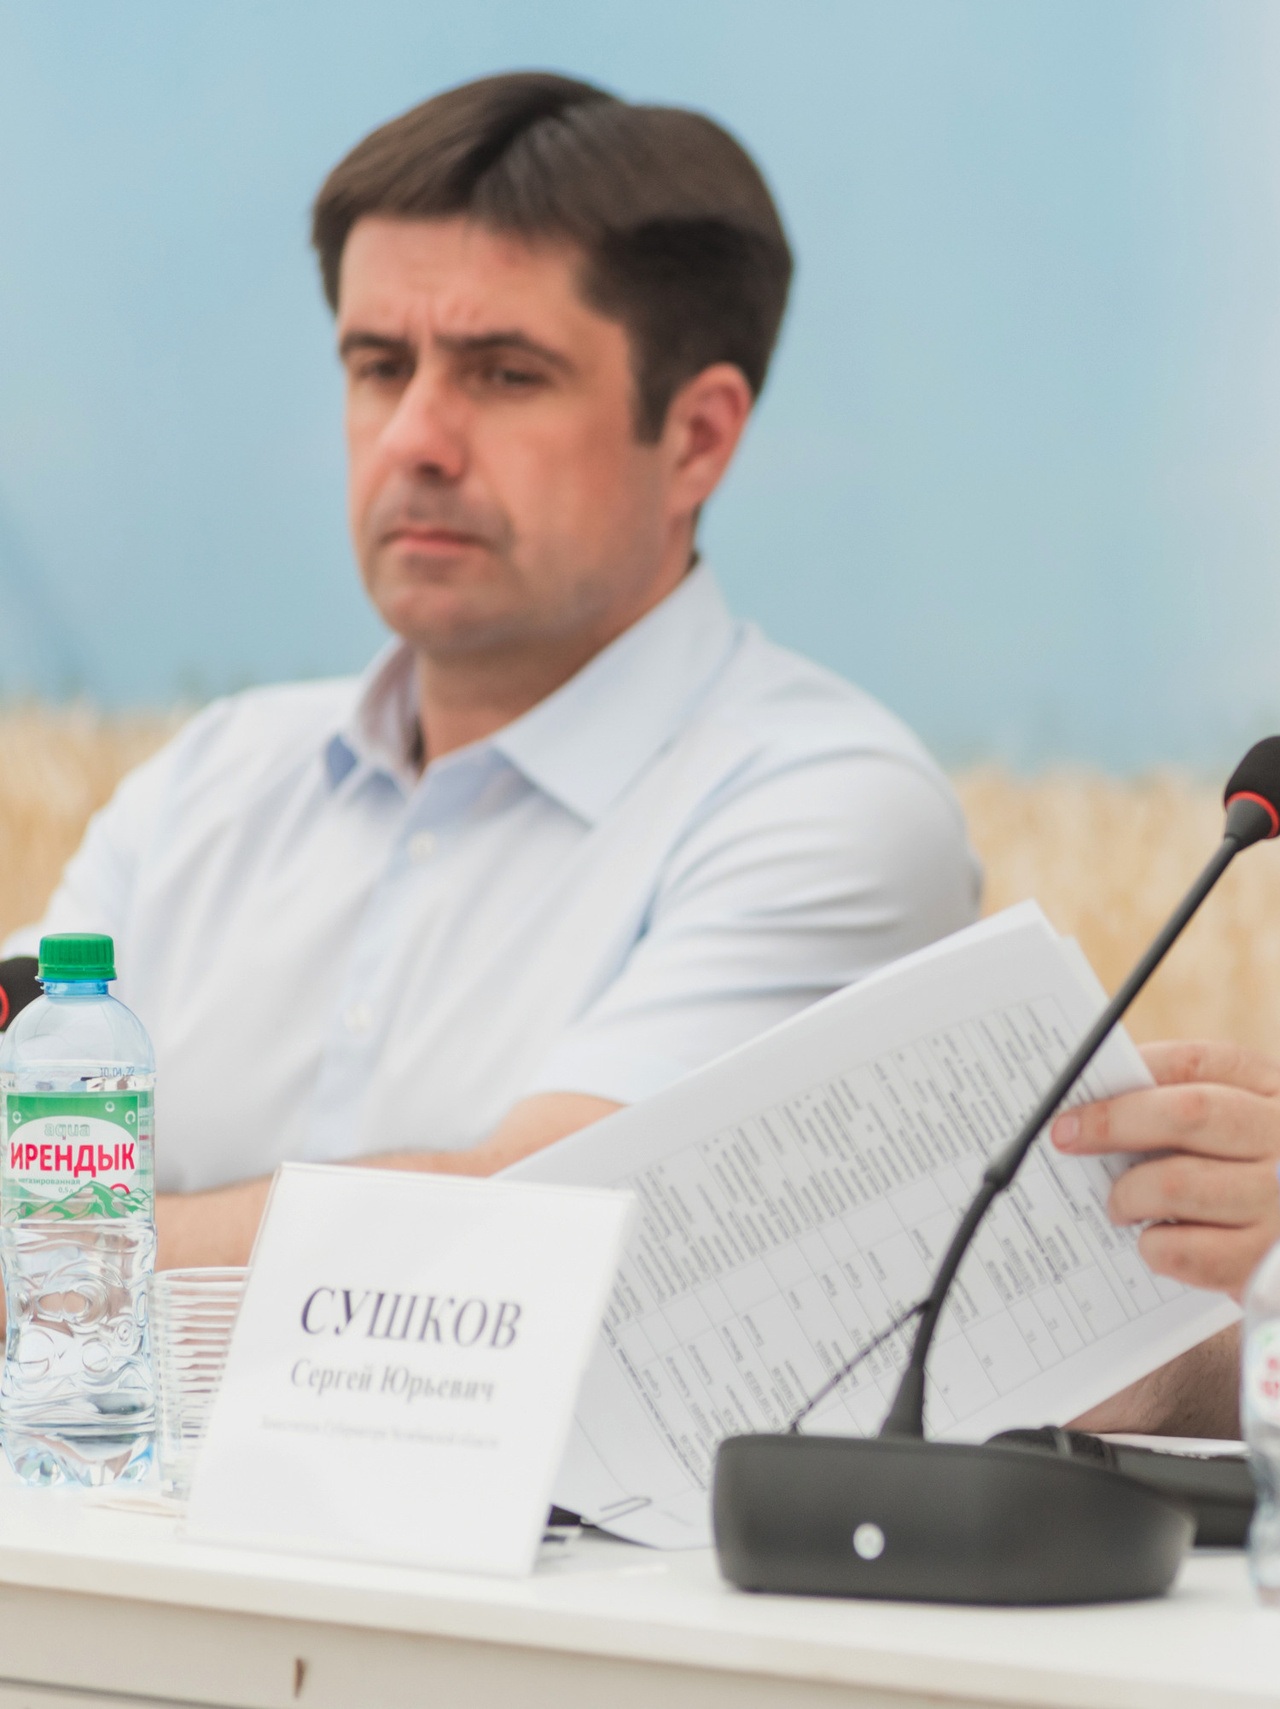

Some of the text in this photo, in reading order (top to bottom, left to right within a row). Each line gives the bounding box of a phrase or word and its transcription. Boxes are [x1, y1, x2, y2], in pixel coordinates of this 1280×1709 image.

[44, 1123, 91, 1140] aqua
[11, 1142, 136, 1178] ИРЕНДЫК
[300, 1286, 523, 1350] СУШКОВ
[291, 1358, 496, 1404] Сергей Юрьевич
